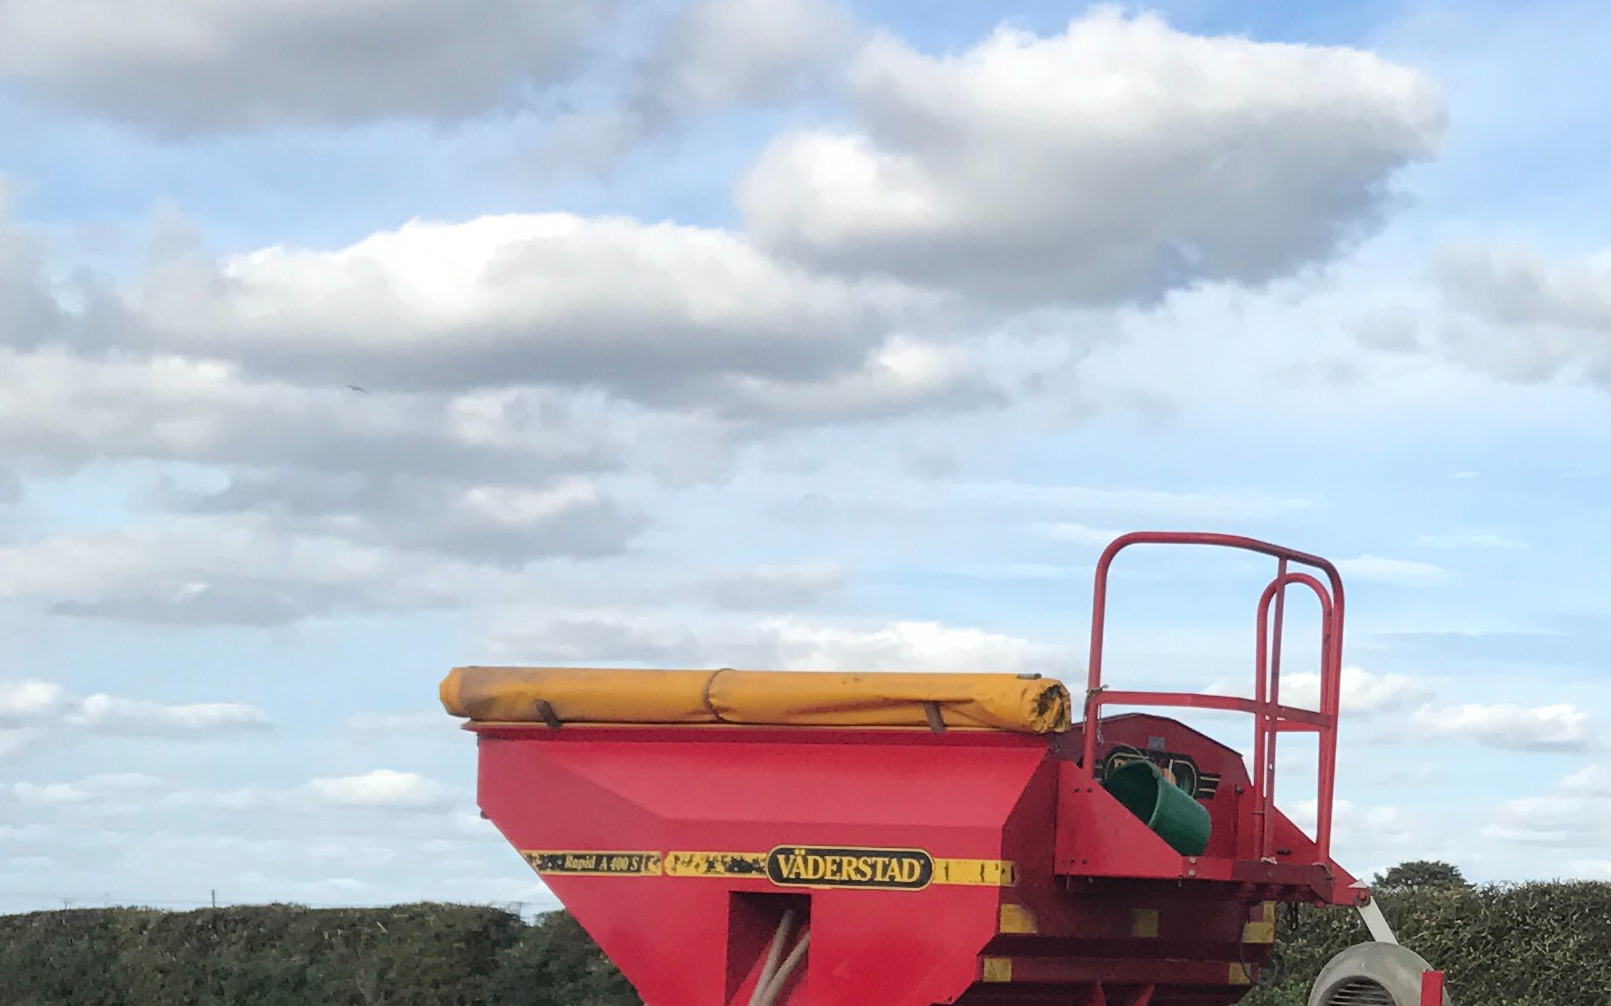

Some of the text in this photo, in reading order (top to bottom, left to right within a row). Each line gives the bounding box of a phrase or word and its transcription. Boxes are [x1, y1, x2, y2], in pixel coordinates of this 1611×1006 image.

[564, 855, 596, 870] Rapid
[600, 856, 608, 871] A
[610, 856, 629, 871] 400
[777, 848, 922, 883] VÄDERSTAD
